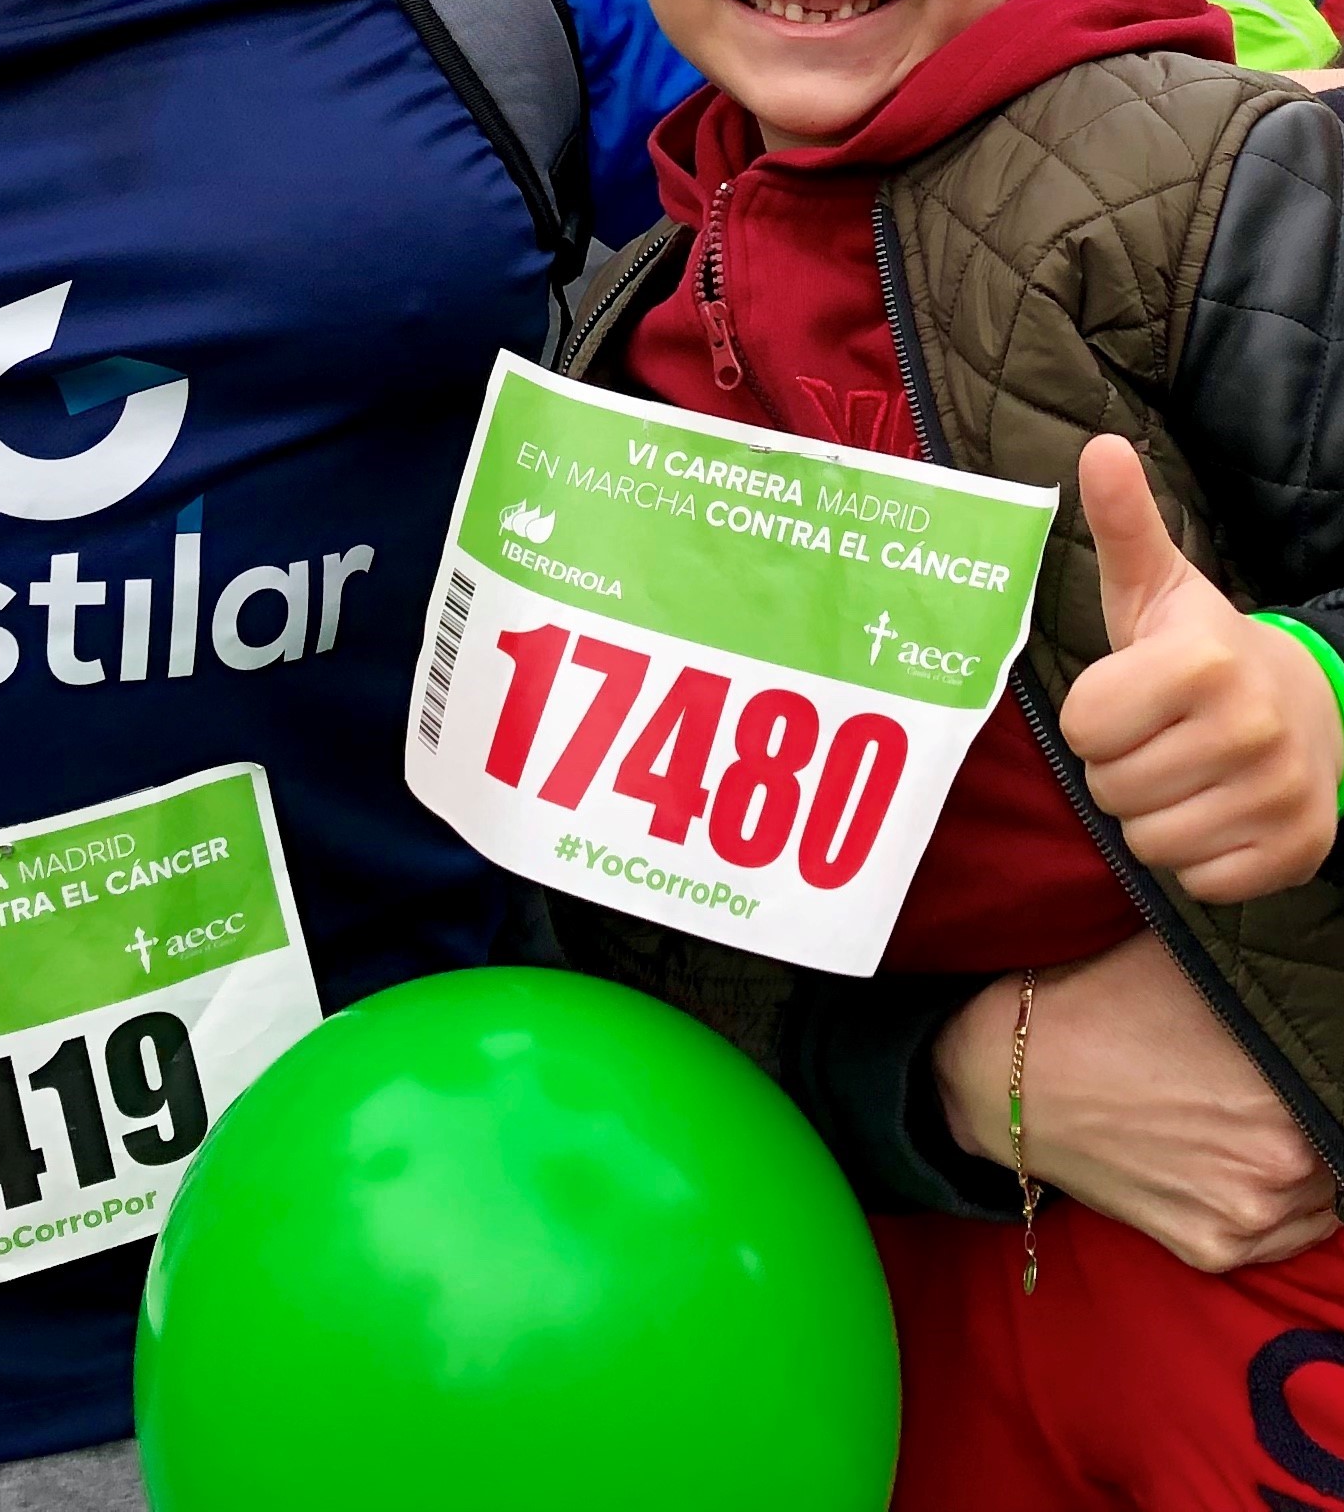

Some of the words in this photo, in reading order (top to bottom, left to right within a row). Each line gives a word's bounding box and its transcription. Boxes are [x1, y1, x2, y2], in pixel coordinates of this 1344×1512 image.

[515, 441, 559, 480] EN
[565, 456, 697, 521] MARCHA
[704, 501, 833, 554] CONTRA
[837, 531, 871, 563] EL
[879, 528, 1011, 594] CÁNCER
[625, 438, 658, 472] VI
[662, 449, 803, 507] CARRERA
[815, 488, 932, 535] MADRID
[500, 539, 624, 600] IBERDROLA
[897, 641, 982, 677] aecc
[484, 622, 909, 890] 17480
[17, 832, 137, 883] MADRID
[60, 883, 100, 910] EL
[104, 835, 231, 896] CÁNCER
[553, 831, 761, 921] #YoCorroPor
[165, 912, 246, 956] aecc
